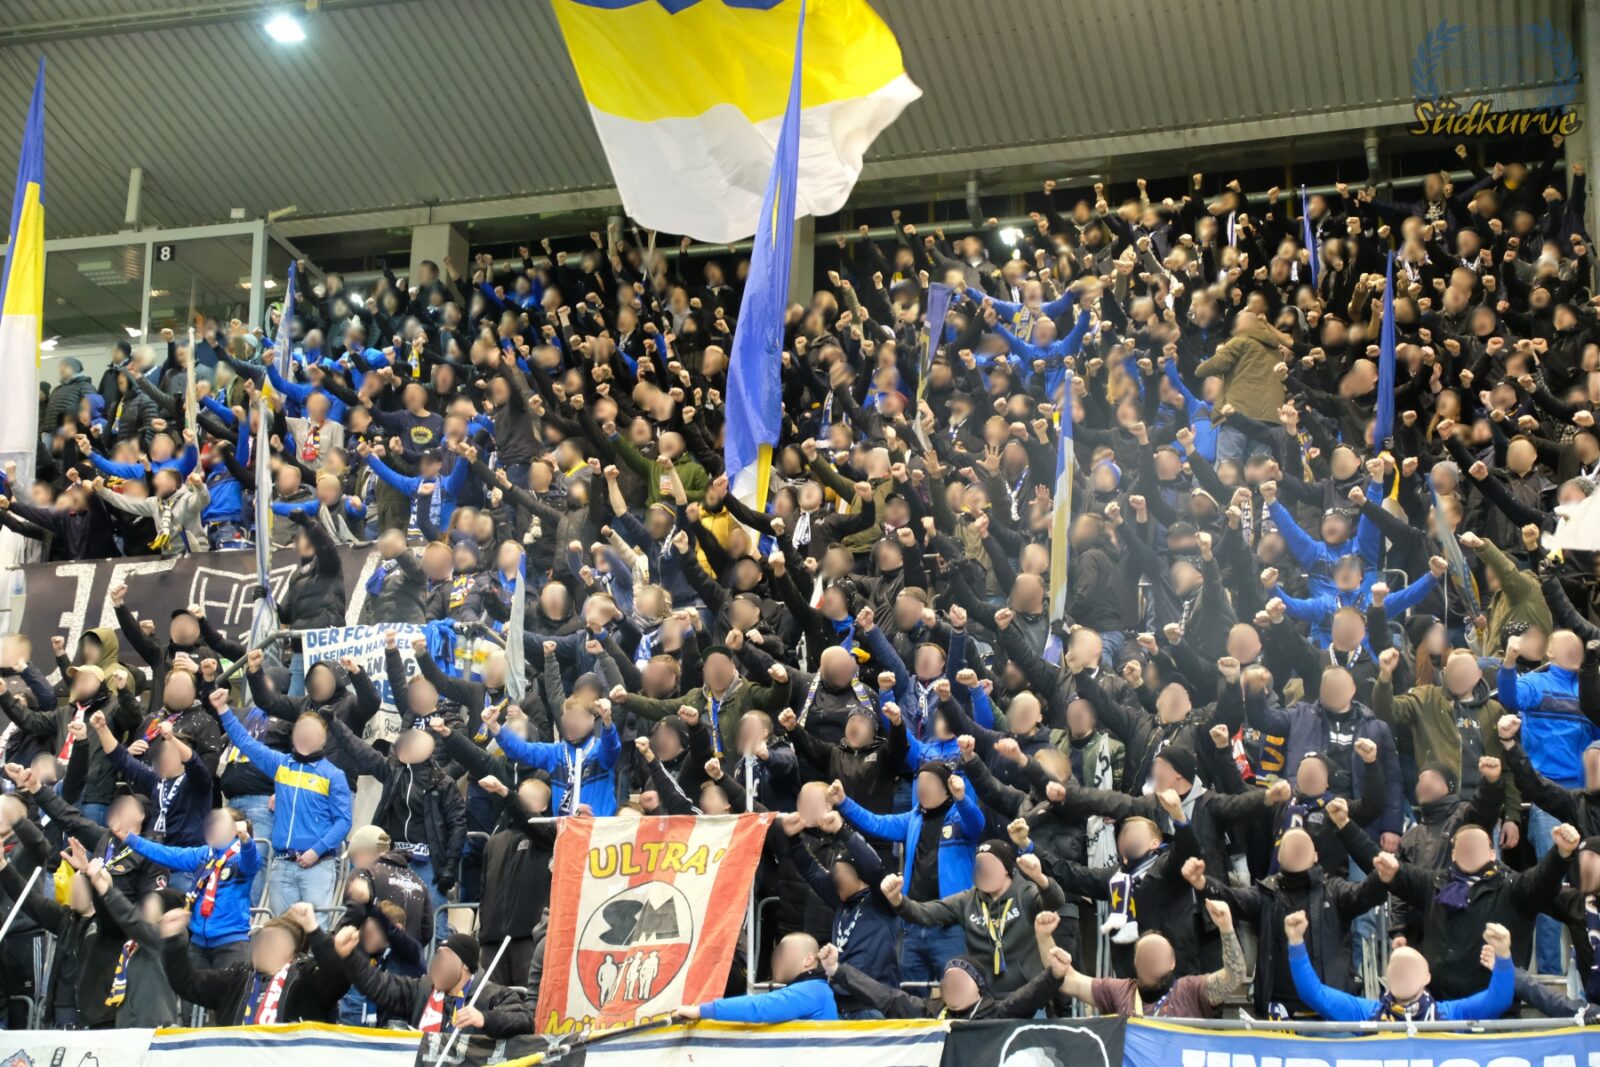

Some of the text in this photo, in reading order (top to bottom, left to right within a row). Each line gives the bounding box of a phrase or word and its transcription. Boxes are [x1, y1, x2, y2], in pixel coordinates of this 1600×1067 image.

[160, 246, 171, 261] 8
[306, 628, 340, 648] DER
[365, 637, 411, 655] HANEL
